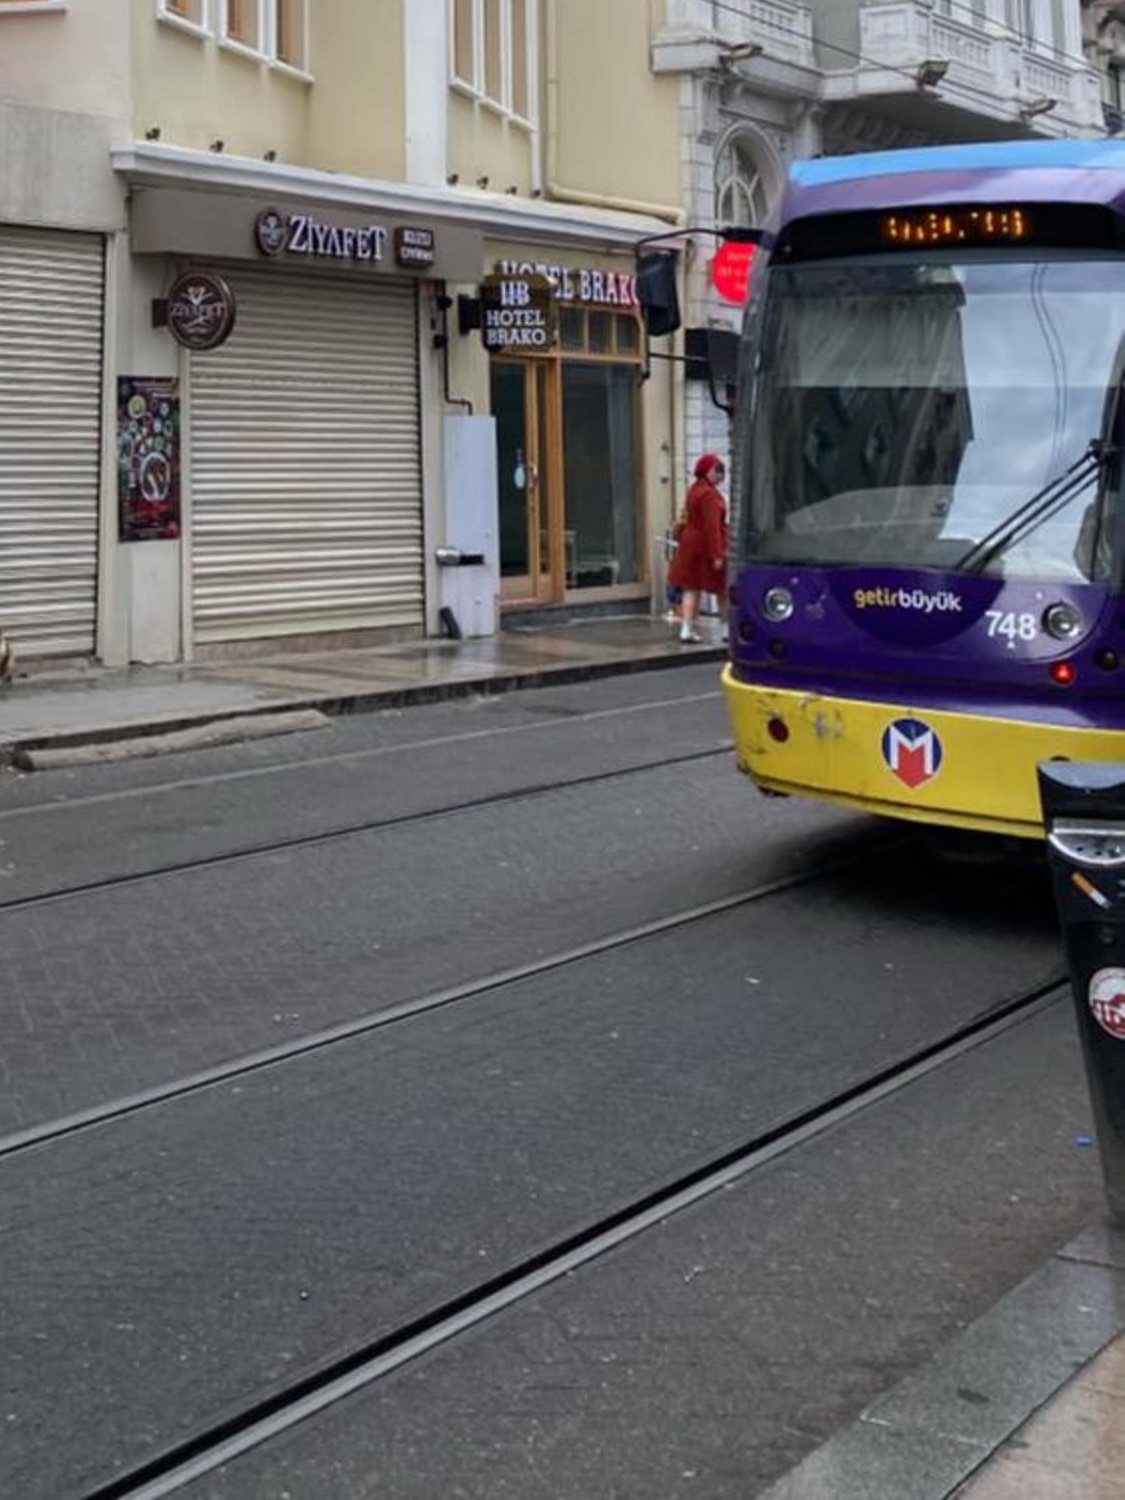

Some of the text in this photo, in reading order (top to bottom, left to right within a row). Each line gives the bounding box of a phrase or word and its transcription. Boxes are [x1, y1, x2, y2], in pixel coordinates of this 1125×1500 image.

[486, 309, 546, 327] HOTEL
[487, 328, 547, 346] BRAKO
[854, 587, 963, 613] getirbüyük
[985, 610, 1036, 641] 748
